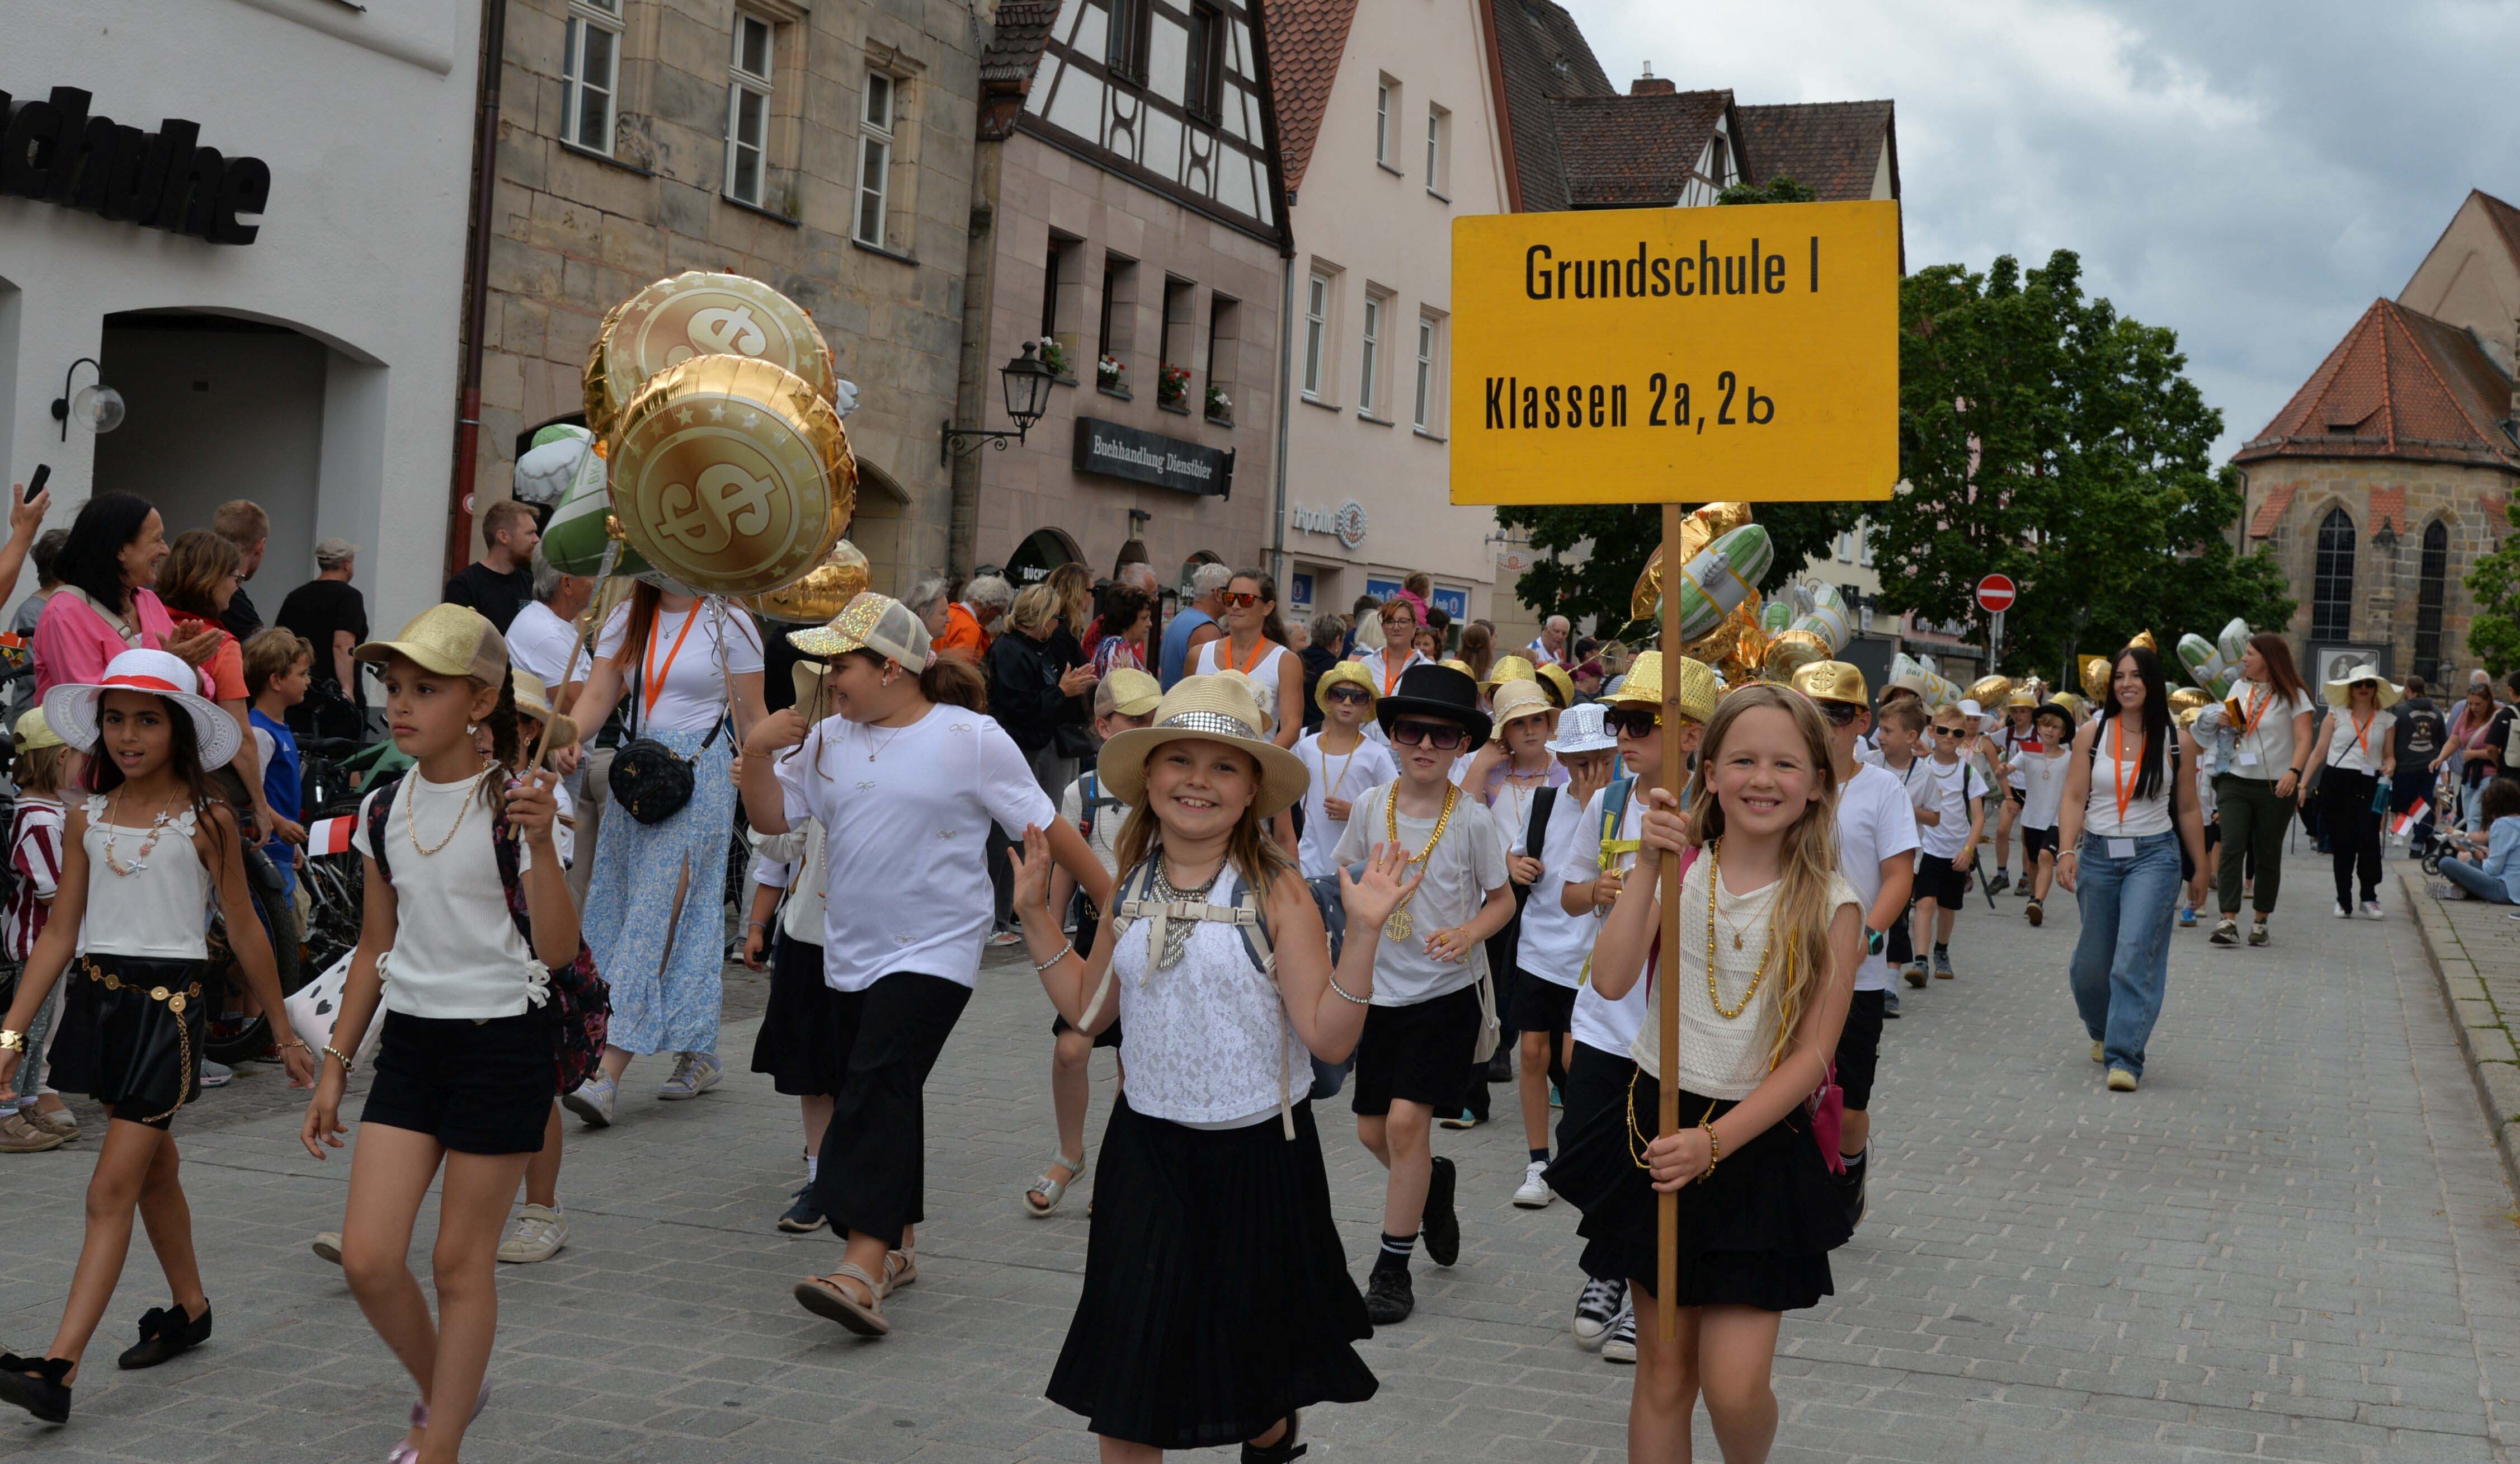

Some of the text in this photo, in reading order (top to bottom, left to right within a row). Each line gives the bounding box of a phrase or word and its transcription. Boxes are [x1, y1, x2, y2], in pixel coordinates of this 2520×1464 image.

[1526, 238, 1786, 300] Grundschule
[1486, 376, 1627, 430] Klassen
[1093, 435, 1212, 479] Buchhandlung Dienstbier
[1294, 502, 1336, 537] Apollo
[1023, 564, 1051, 581] BÜCH
[1181, 583, 1195, 597] BÜC
